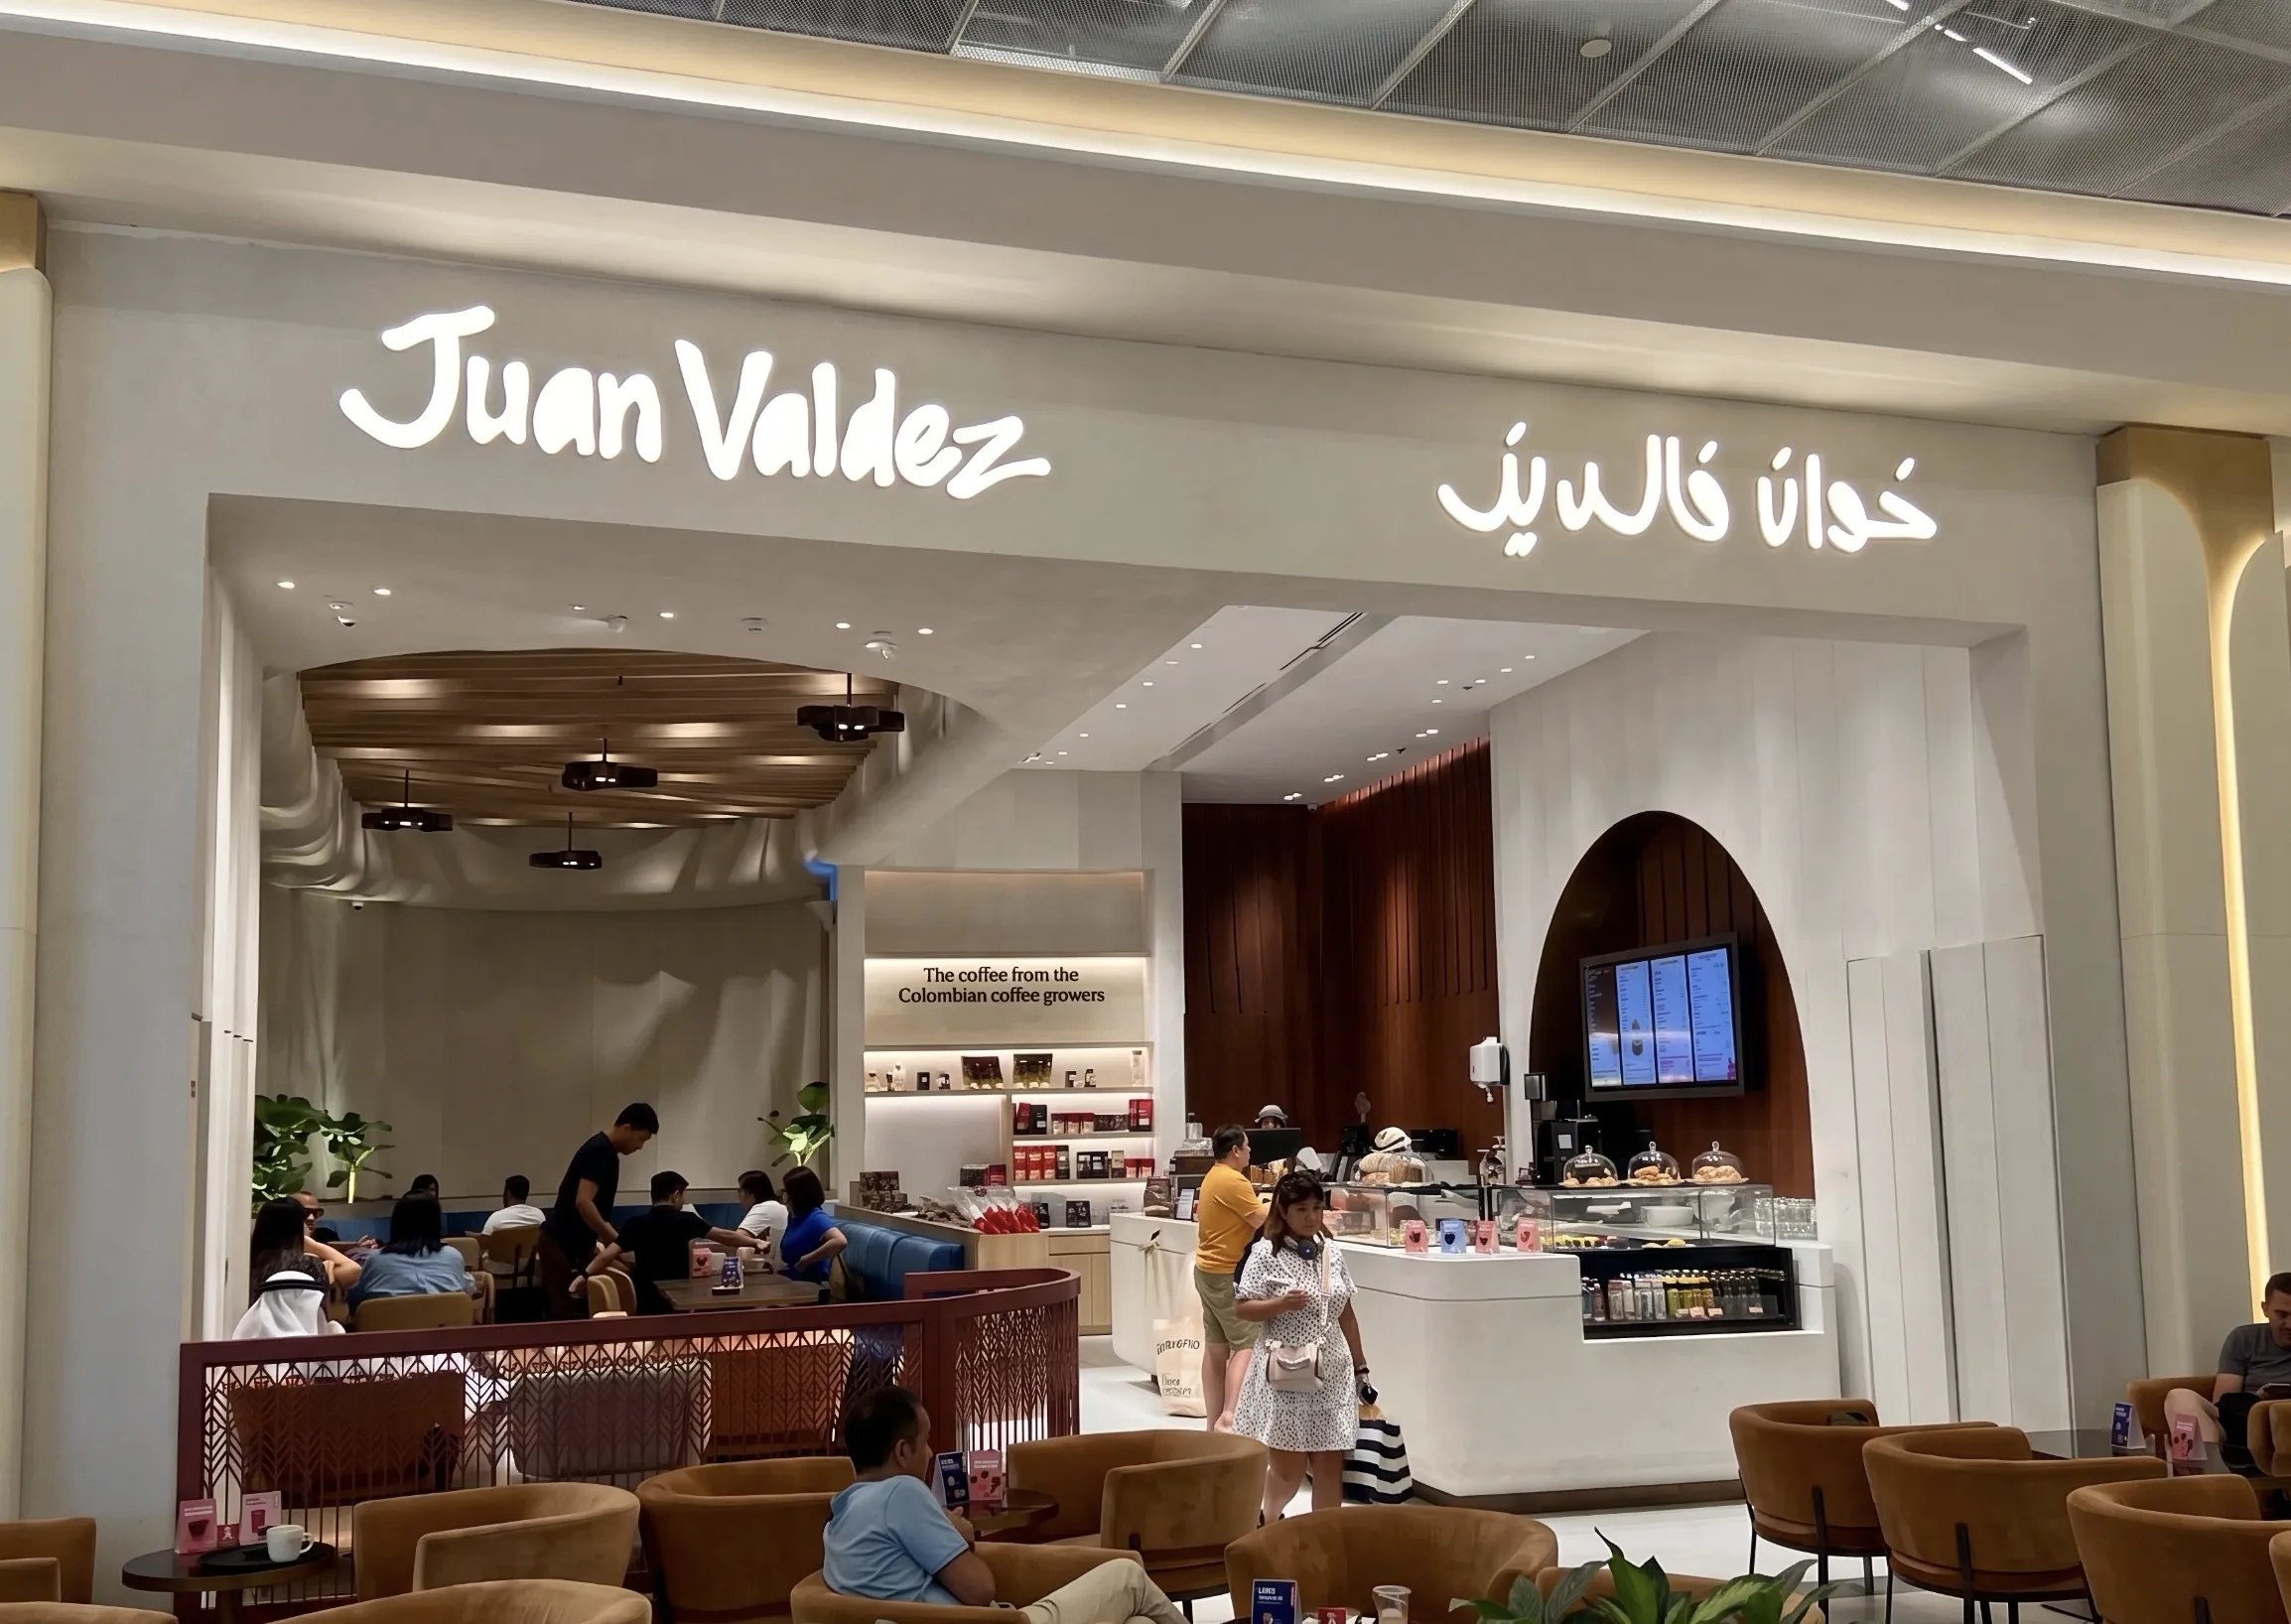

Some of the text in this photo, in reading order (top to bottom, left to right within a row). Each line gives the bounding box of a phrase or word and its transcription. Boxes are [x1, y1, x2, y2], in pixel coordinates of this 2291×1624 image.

[338, 305, 1052, 499] Juan Valdez
[1437, 421, 1938, 557] خوان فالديز
[898, 986, 1106, 1007] Colombian coffee growers
[923, 966, 1079, 983] The coffee from the
